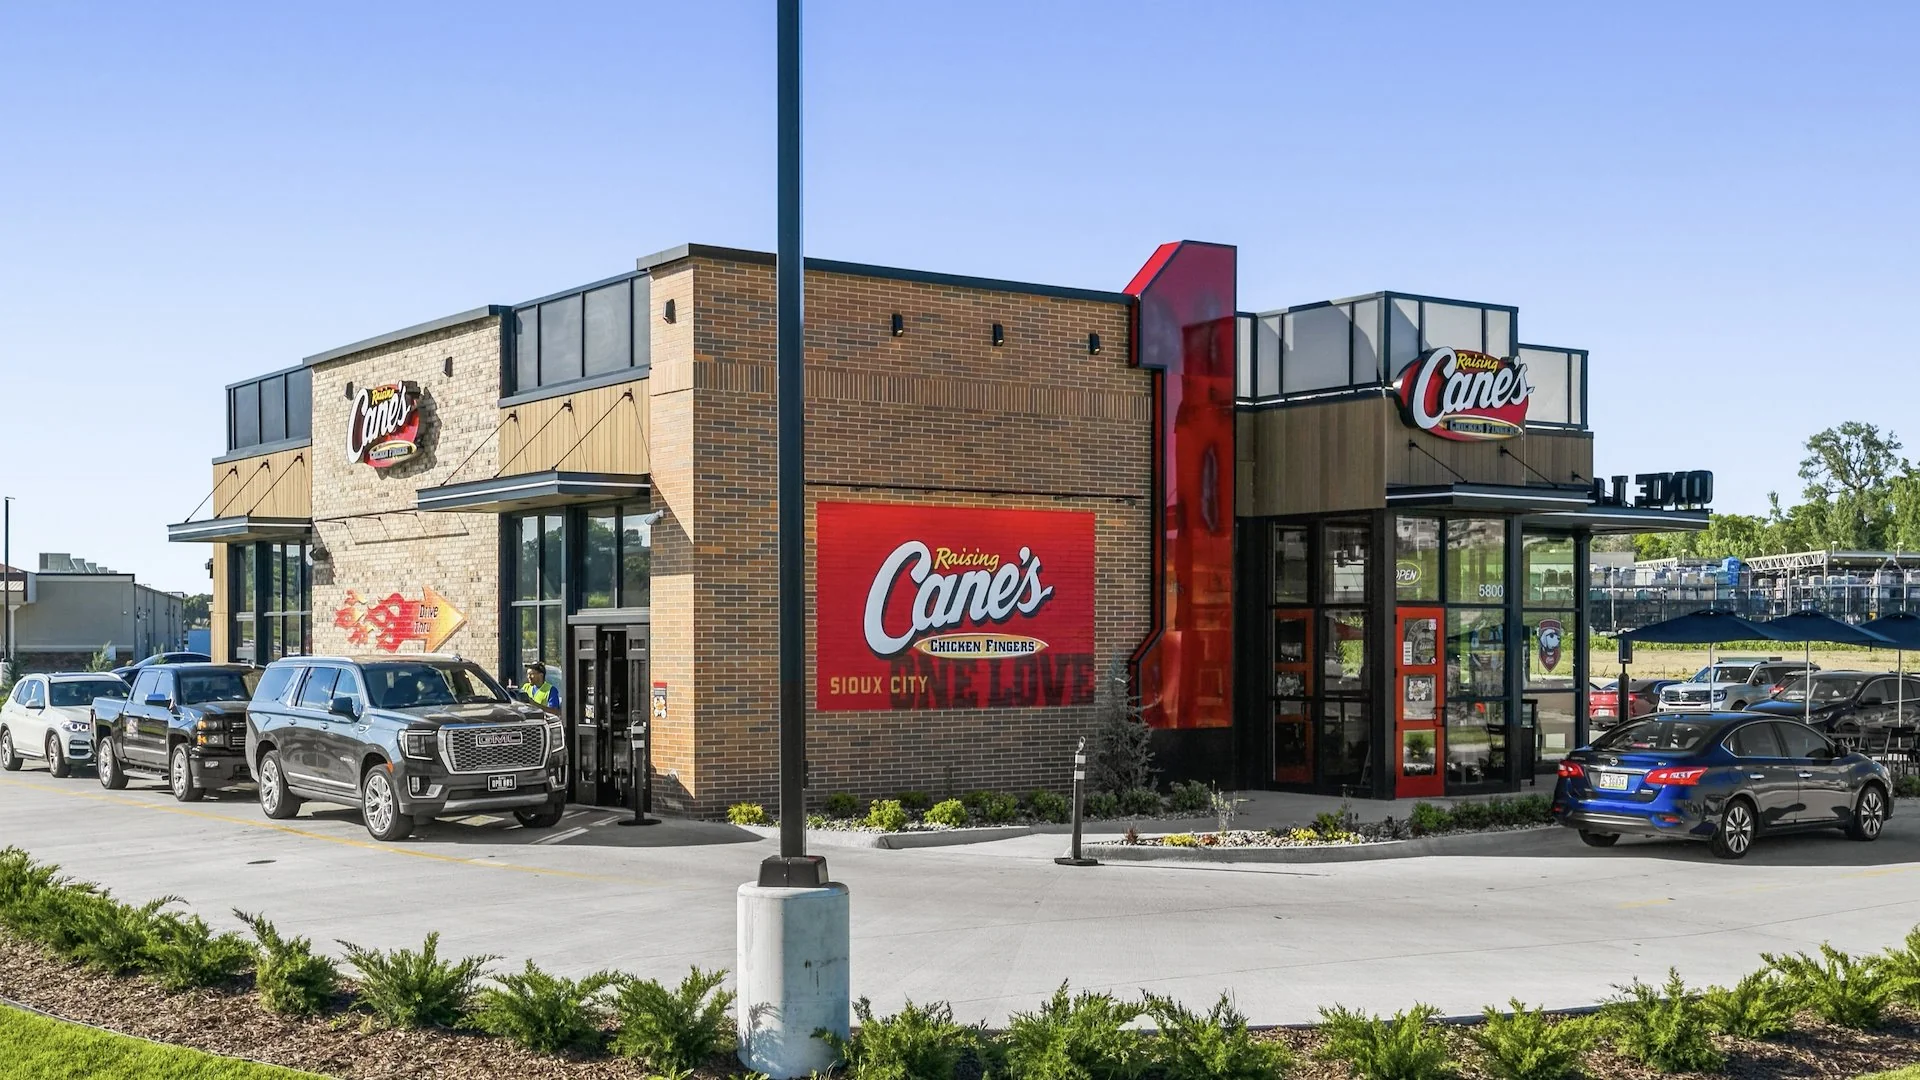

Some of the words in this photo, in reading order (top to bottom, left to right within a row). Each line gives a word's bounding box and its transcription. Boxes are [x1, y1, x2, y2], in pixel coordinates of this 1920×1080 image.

[1456, 353, 1499, 373] Raising
[1413, 346, 1535, 429] Cane's
[346, 380, 411, 464] Cane's
[934, 547, 1000, 572] Raising
[863, 540, 1054, 655] Cane's
[1479, 584, 1504, 598] 5800
[419, 604, 439, 618] Drive
[414, 621, 431, 633] Thru
[930, 639, 981, 652] CHICKEN
[985, 639, 1035, 653] FINGERS
[830, 676, 883, 695] SIOUX
[890, 676, 929, 694] CITY
[890, 655, 980, 709] ONE
[988, 653, 1094, 709] LOVE
[479, 731, 521, 745] GMC
